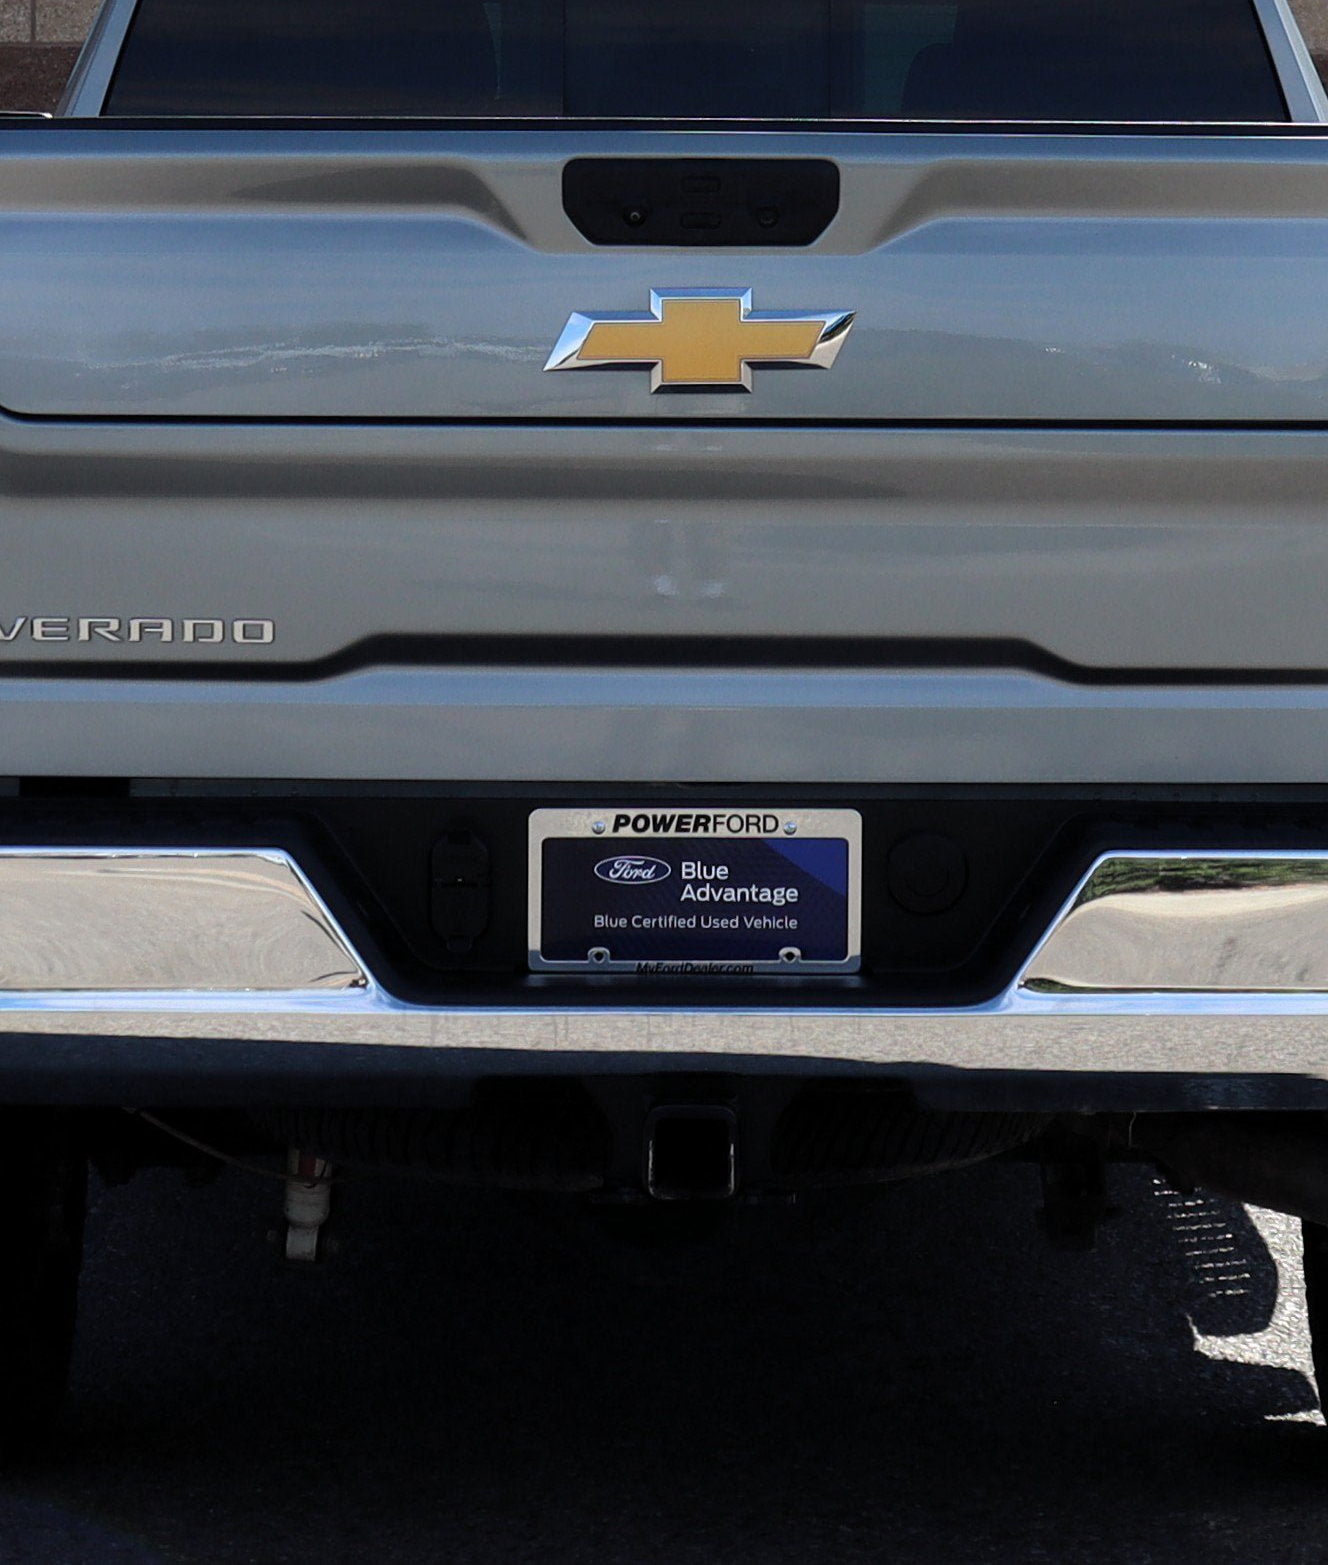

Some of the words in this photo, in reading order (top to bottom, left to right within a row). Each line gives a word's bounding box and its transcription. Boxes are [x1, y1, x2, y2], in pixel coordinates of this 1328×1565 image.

[612, 813, 779, 833] POWERFORD
[608, 859, 656, 879] Ford
[681, 861, 729, 880] Blue
[680, 883, 799, 905] Advantage
[594, 915, 627, 928] Blue
[631, 915, 696, 929] Certified
[700, 915, 739, 929] Used
[743, 915, 798, 929] Vehicle
[635, 962, 754, 975] MyFordDealer.com
